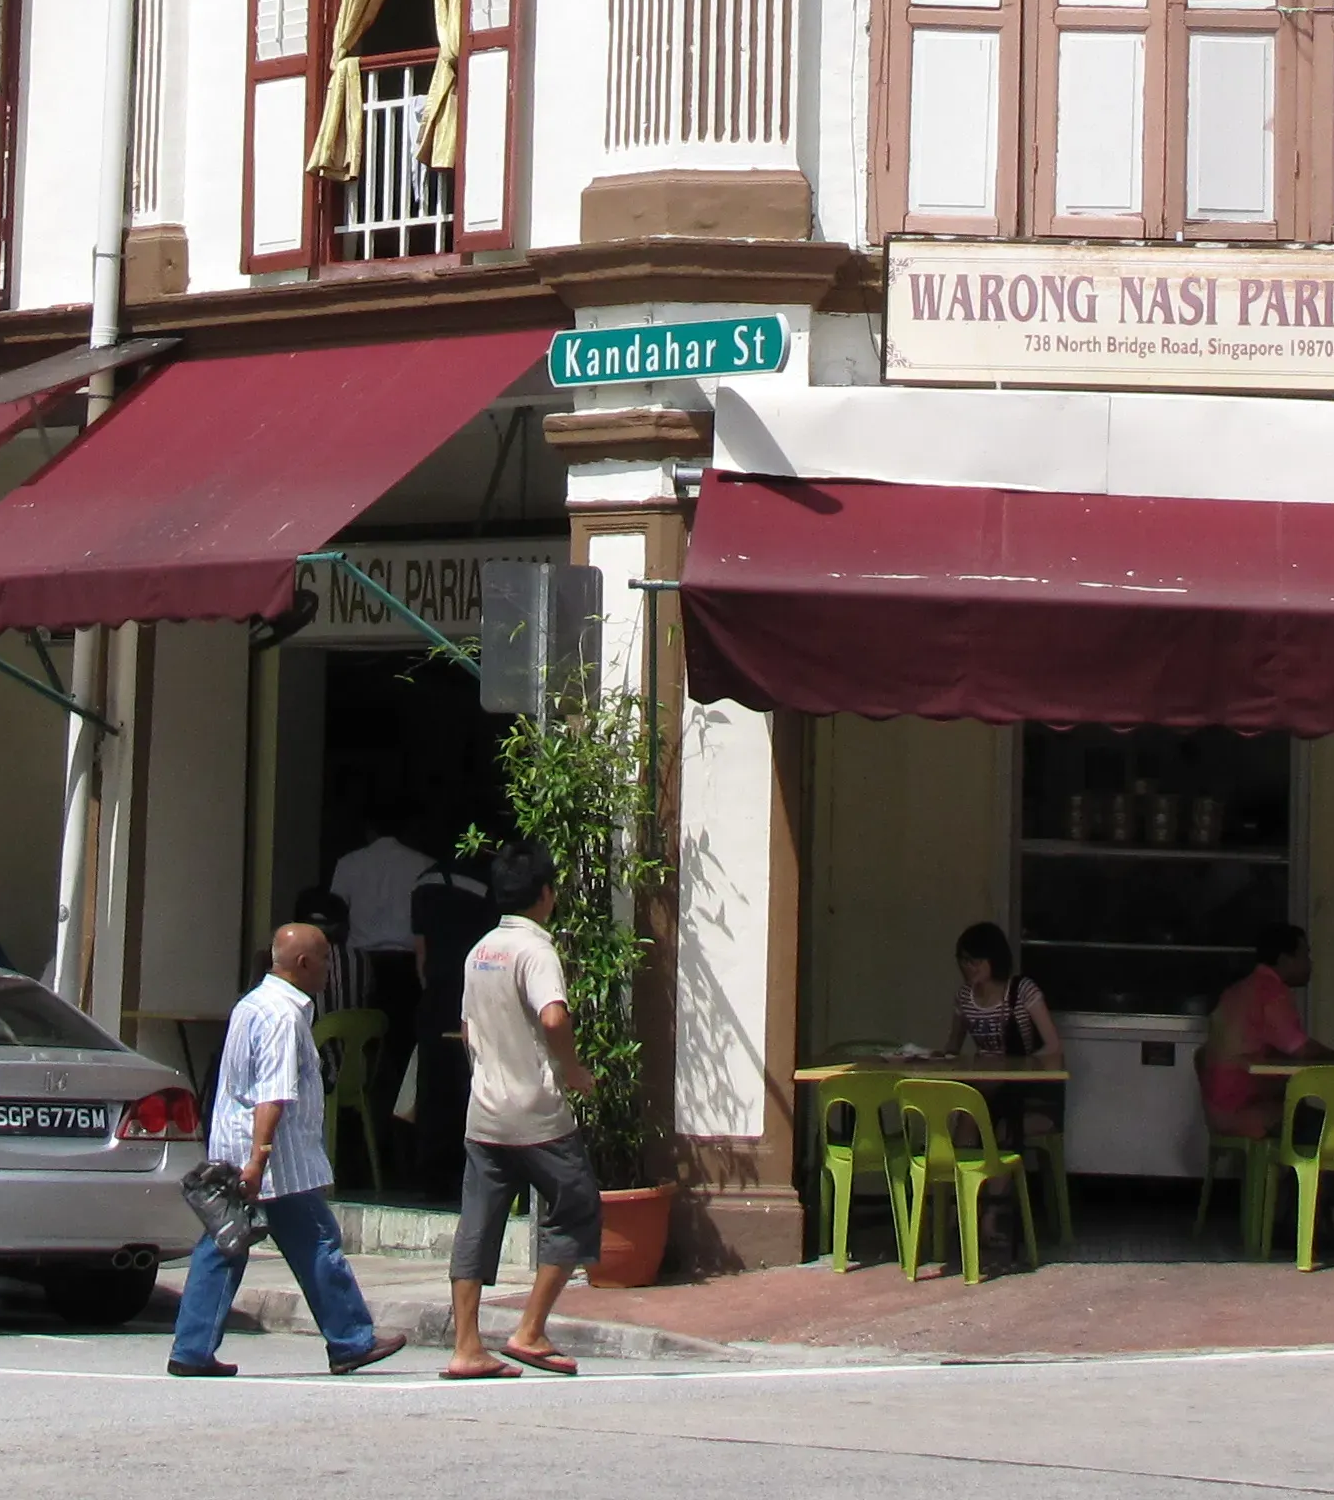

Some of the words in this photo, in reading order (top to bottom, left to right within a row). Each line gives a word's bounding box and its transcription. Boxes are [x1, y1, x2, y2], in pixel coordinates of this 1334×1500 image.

[908, 273, 1098, 324] WARONG
[1118, 276, 1218, 326] NASI
[565, 331, 717, 378] Kandahar
[732, 325, 766, 366] St
[1024, 335, 1051, 352] 738
[1056, 335, 1102, 353] North
[1107, 336, 1156, 358] Bridge
[1161, 337, 1203, 358] Road,
[1208, 338, 1284, 361] Singapore
